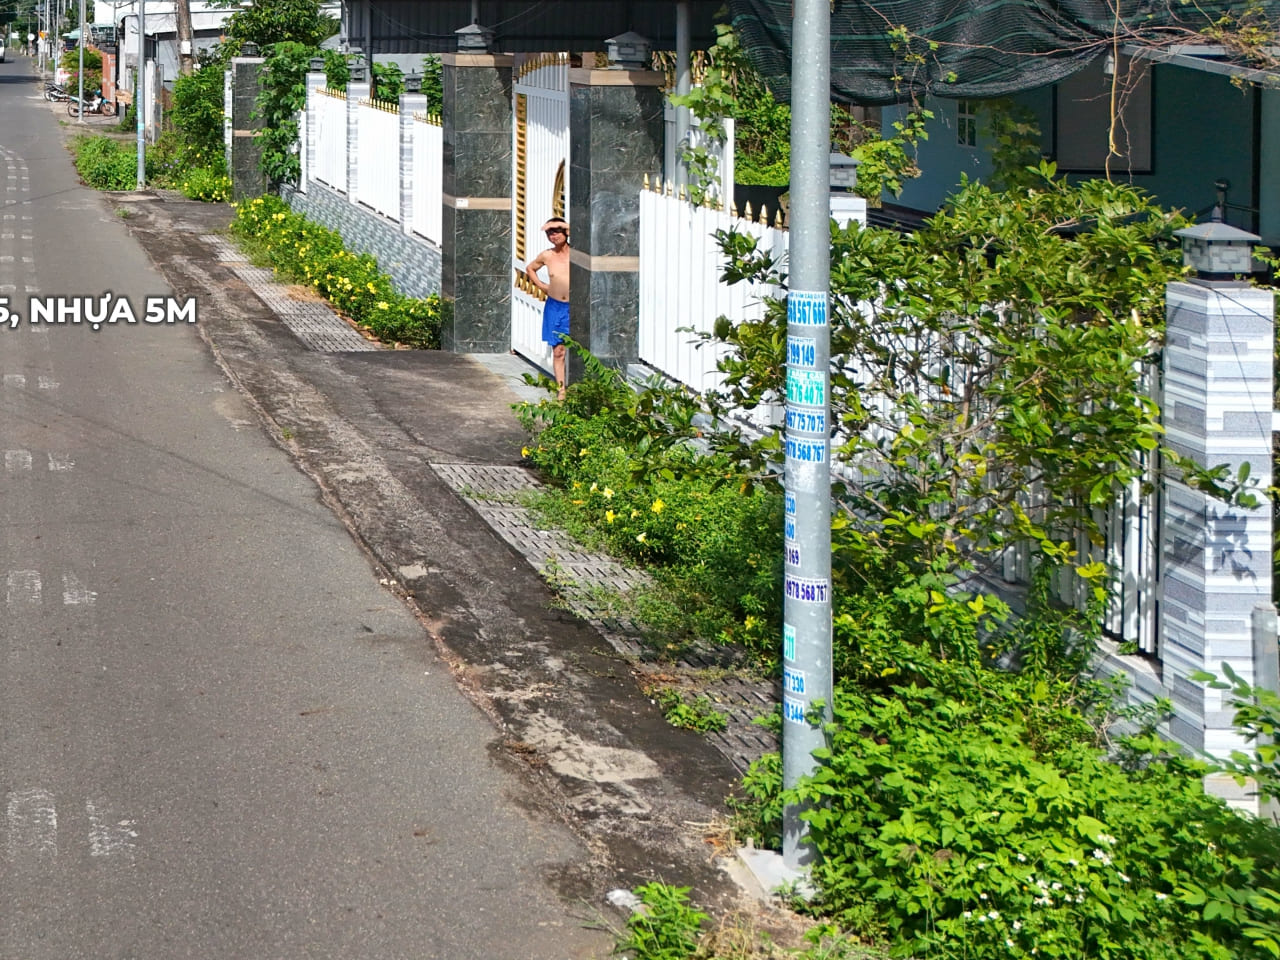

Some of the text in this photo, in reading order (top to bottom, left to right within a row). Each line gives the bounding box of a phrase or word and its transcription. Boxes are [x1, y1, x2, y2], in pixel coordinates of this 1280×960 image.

[797, 300, 812, 325] 567
[812, 301, 826, 326] 666
[801, 344, 815, 366] 149
[794, 383, 803, 403] 76
[804, 385, 814, 404] 40
[815, 385, 824, 405] 76
[797, 412, 806, 430] 75
[806, 414, 816, 432] 70
[816, 414, 825, 432] 75
[797, 442, 812, 461] 568
[812, 444, 825, 462] 767
[801, 582, 815, 601] 568
[816, 584, 828, 602] 767
[791, 674, 804, 694] 330
[791, 704, 804, 723] 344
